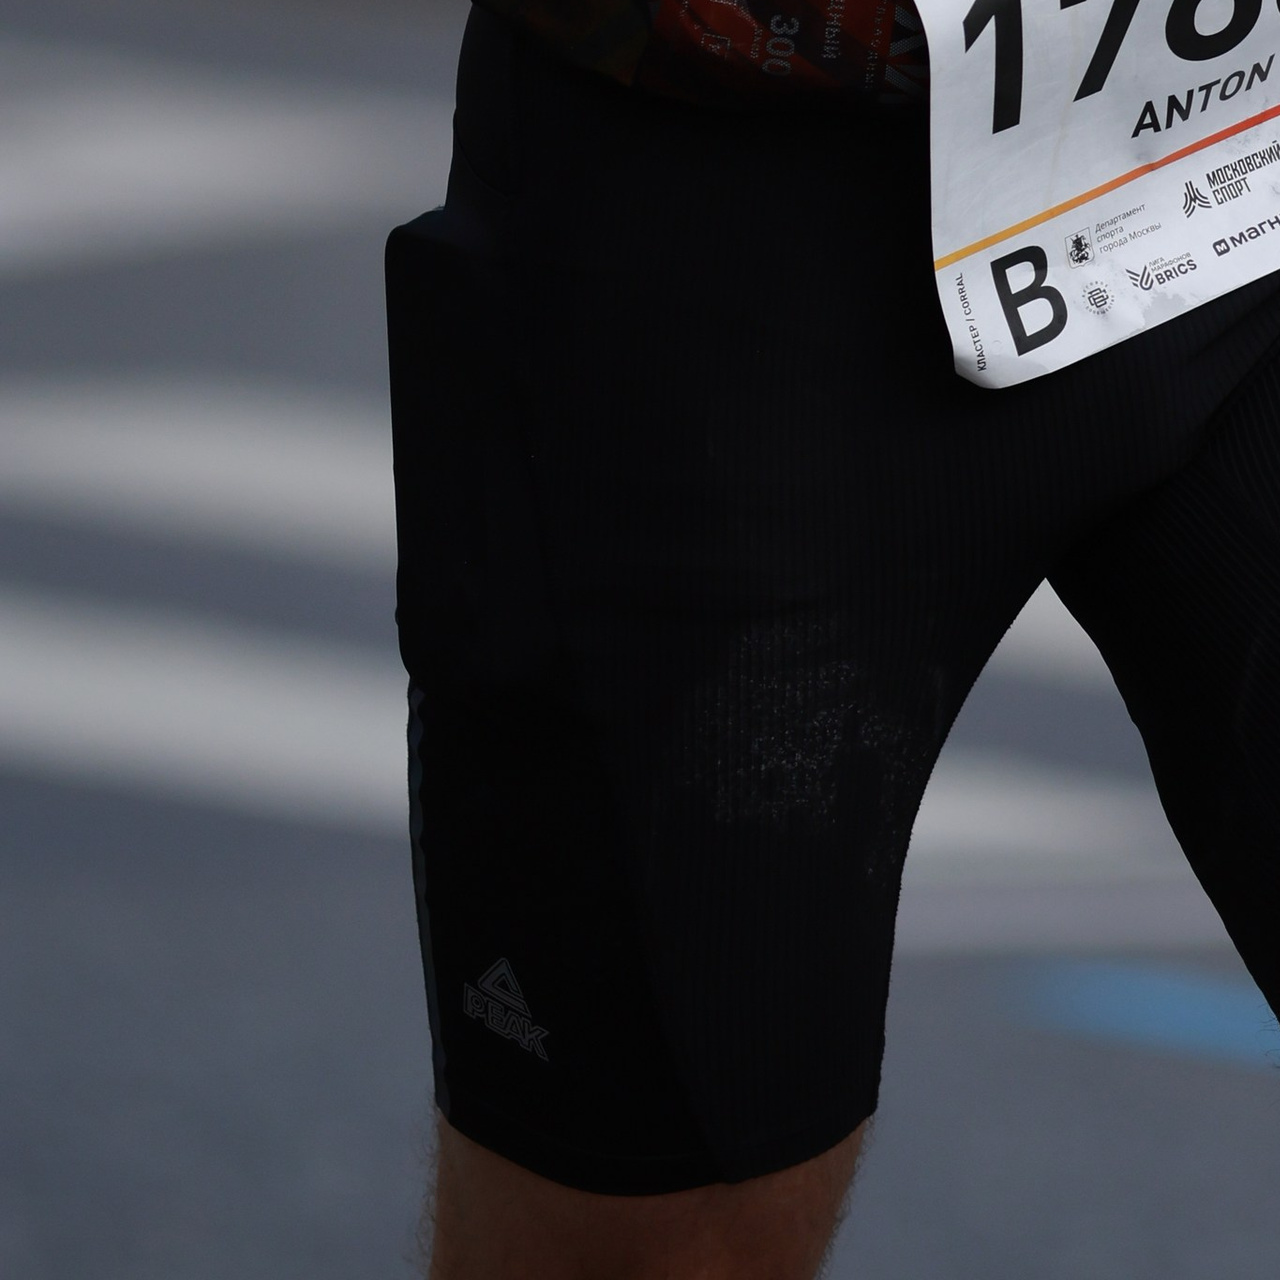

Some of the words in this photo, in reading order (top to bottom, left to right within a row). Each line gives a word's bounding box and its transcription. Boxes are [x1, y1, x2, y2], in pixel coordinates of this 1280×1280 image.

[761, 14, 800, 76] 300
[1131, 53, 1275, 139] ANTON
[1212, 176, 1252, 206] СПОРТ
[1095, 203, 1146, 234] Департамент
[1096, 226, 1124, 244] спорта
[1099, 236, 1129, 254] города
[1128, 222, 1162, 241] Москвы
[1151, 252, 1192, 274] МАРАФОНОВ
[1155, 259, 1198, 286] BRICS
[955, 272, 972, 316] CORRAL
[968, 325, 987, 372] КЛАСТЕР
[463, 982, 550, 1062] PEAK
